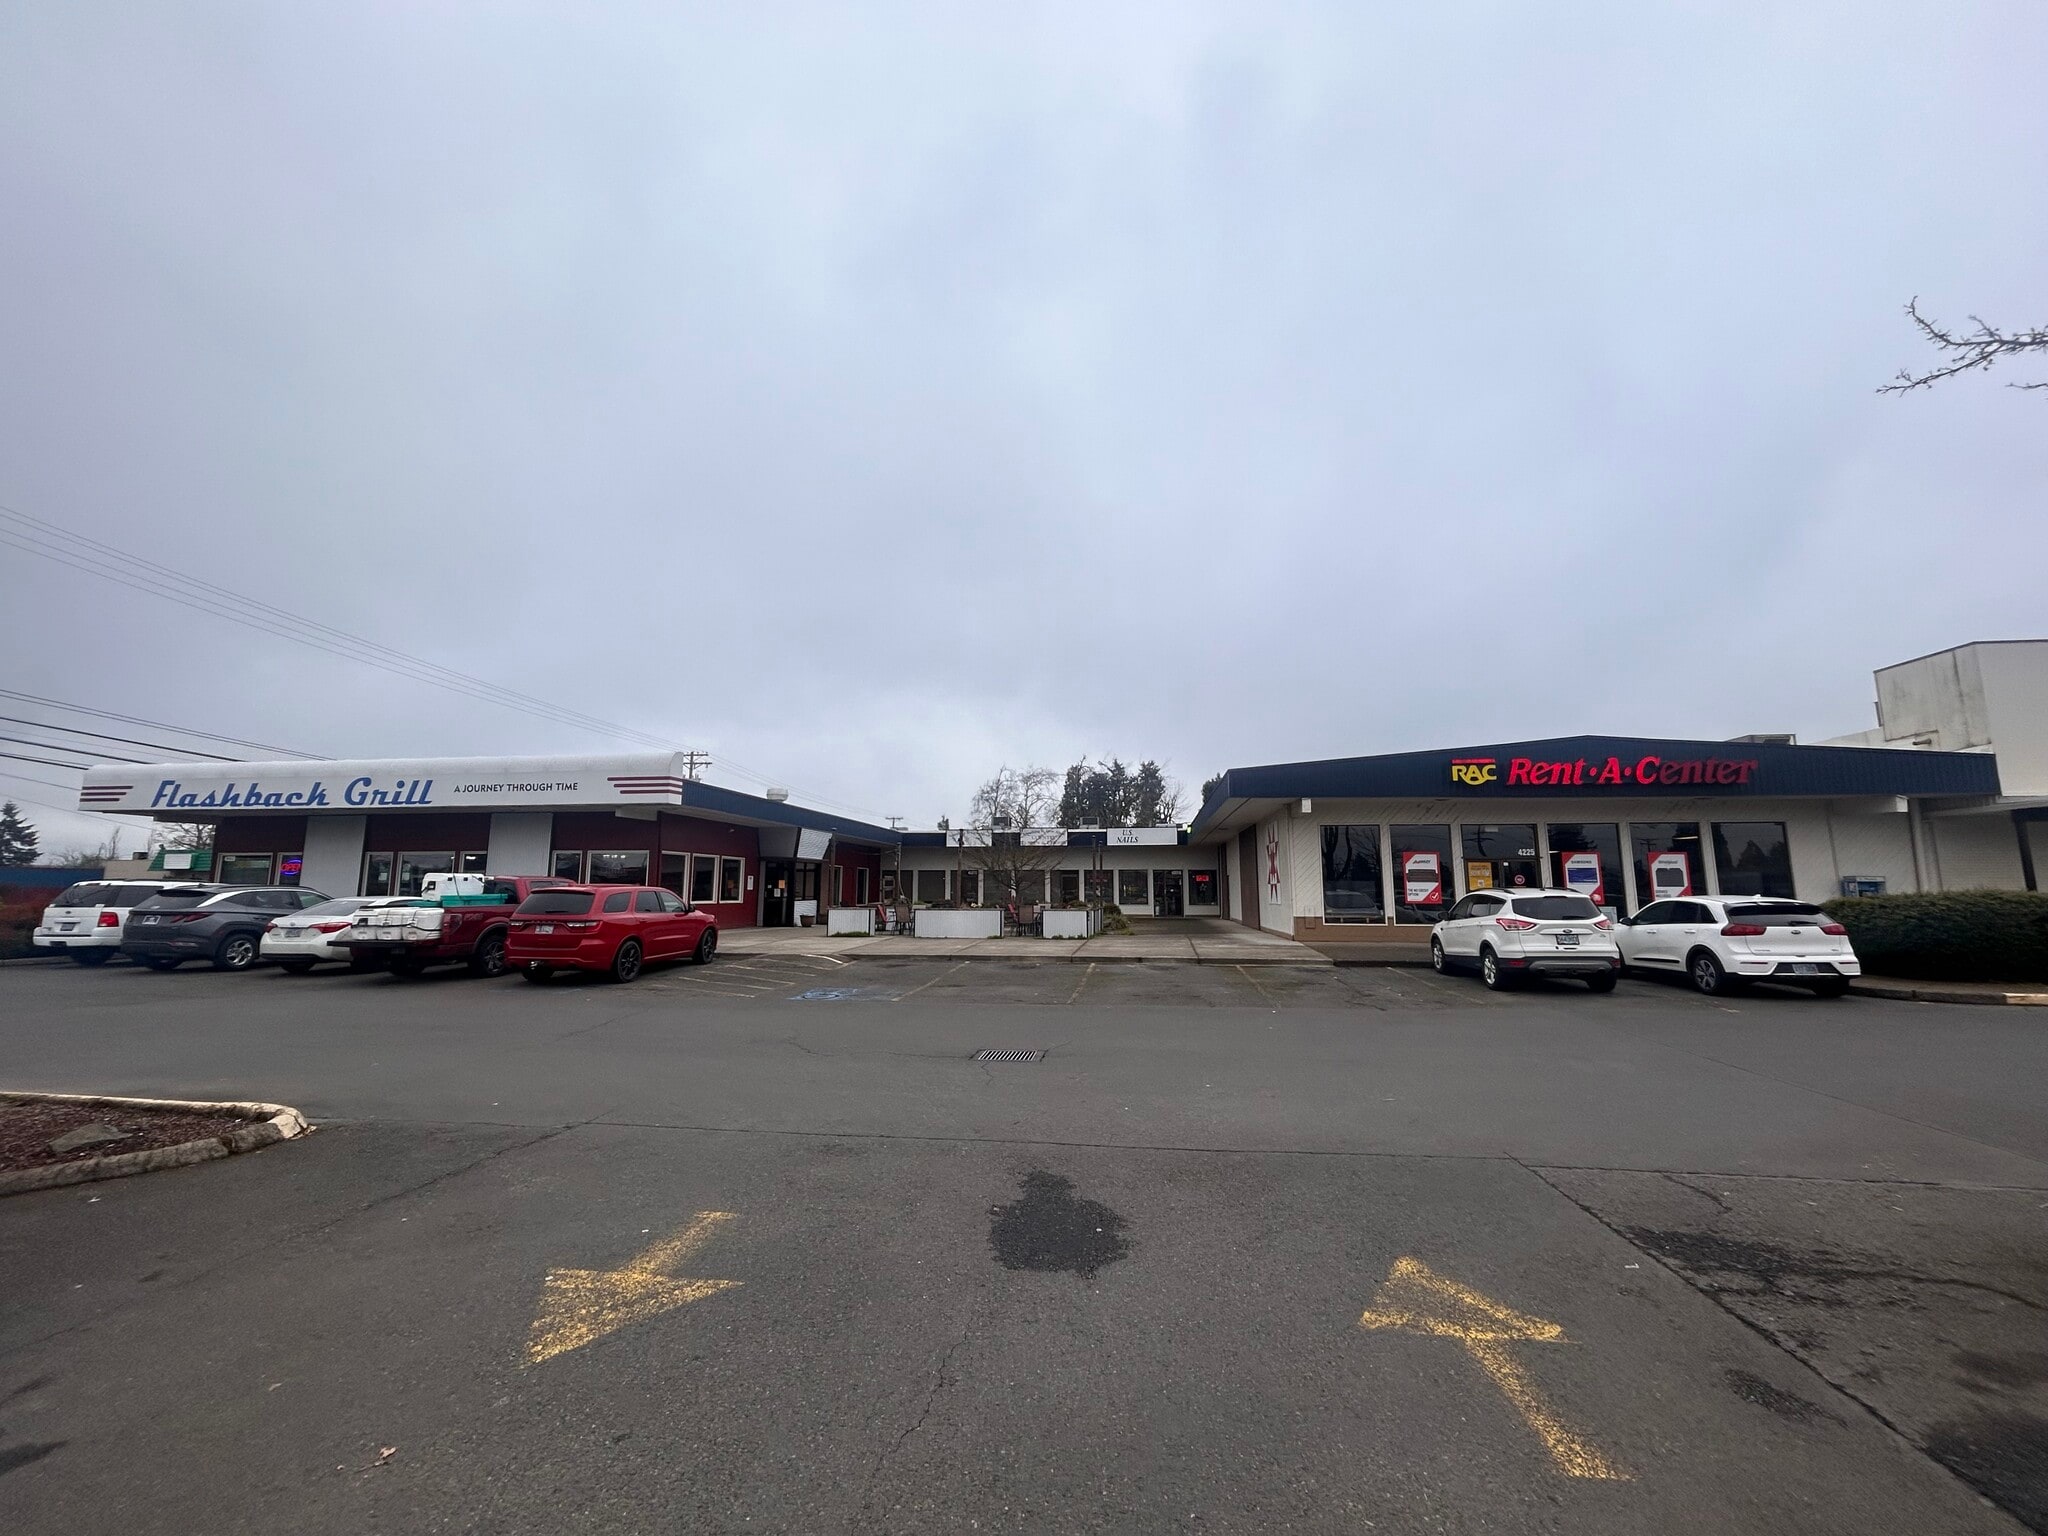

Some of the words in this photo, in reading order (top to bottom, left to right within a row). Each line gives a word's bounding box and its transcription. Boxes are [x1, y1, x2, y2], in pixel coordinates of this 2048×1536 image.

[1451, 764, 1497, 785] RAC
[151, 780, 330, 808] Flashback
[344, 777, 433, 806] Grill
[453, 784, 461, 793] A
[462, 784, 505, 793] JOURNEY
[506, 783, 553, 792] THROUGH
[555, 782, 579, 791] TIME
[1116, 836, 1139, 844] NAILS
[1517, 848, 1536, 856] 4225
